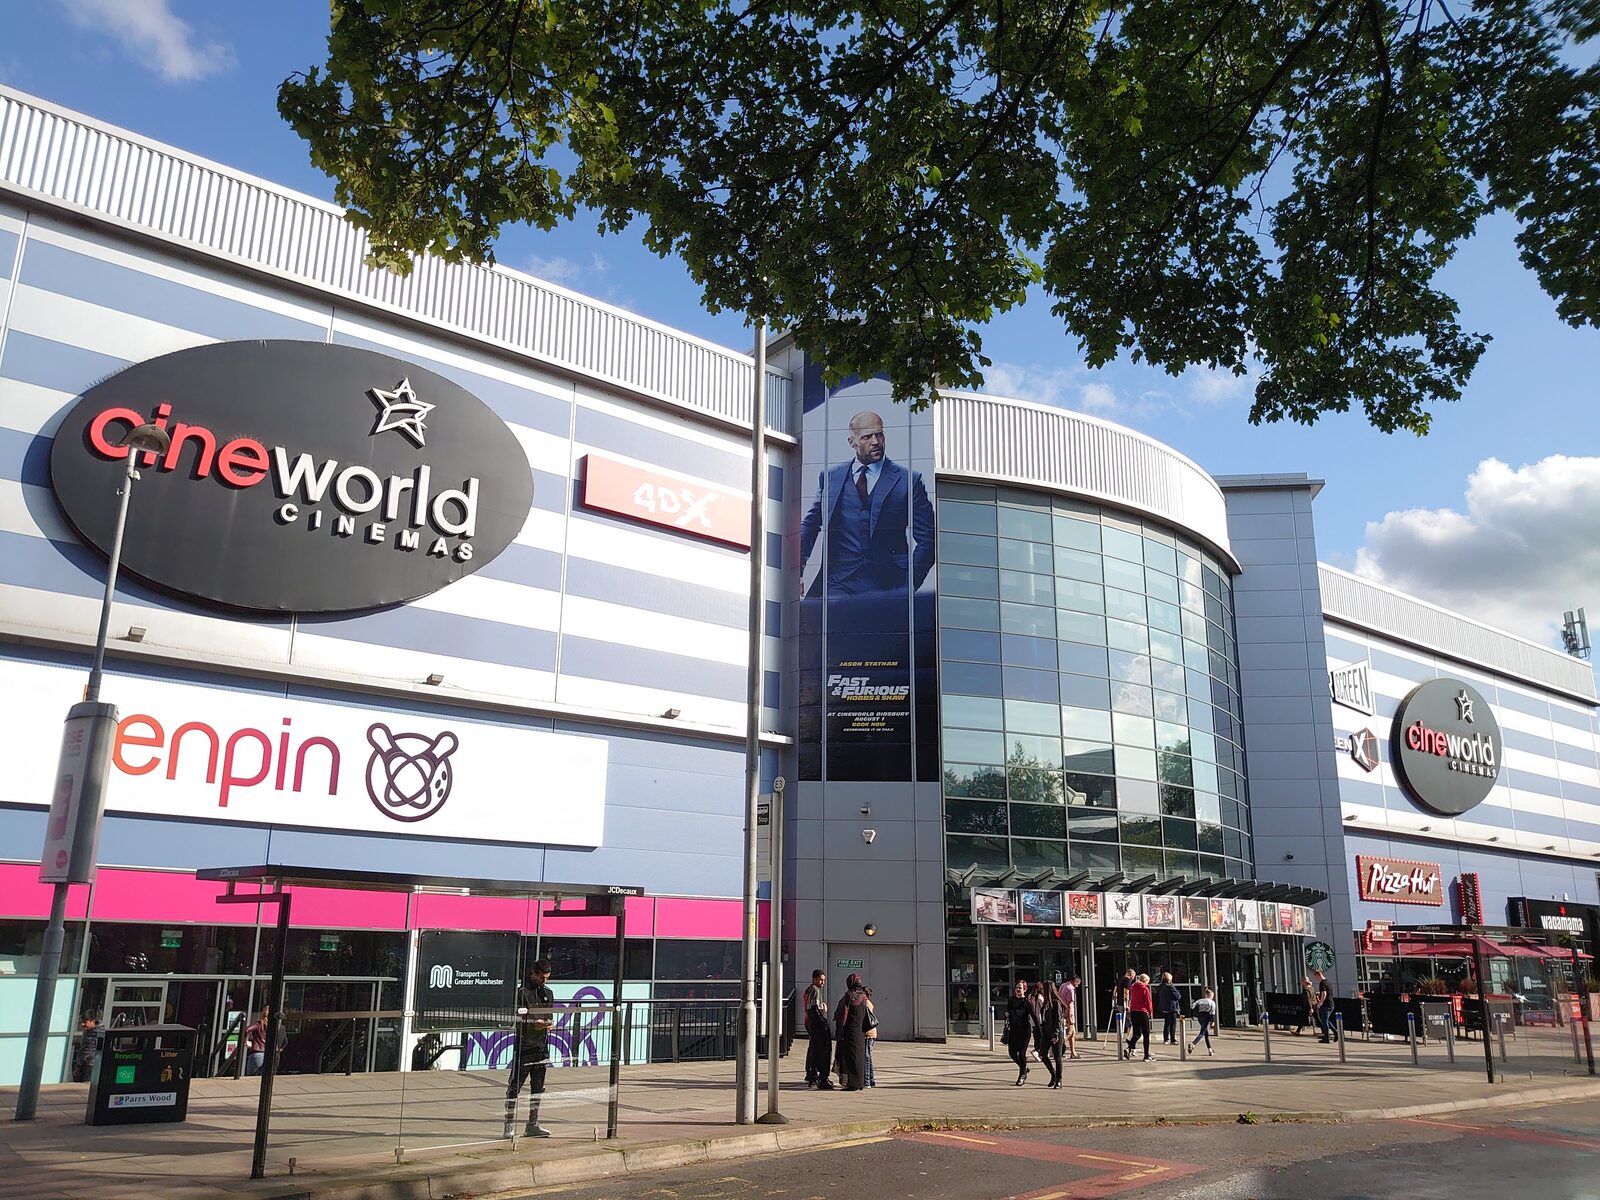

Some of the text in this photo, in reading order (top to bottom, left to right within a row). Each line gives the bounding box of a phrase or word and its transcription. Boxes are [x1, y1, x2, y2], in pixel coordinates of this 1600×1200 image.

[88, 403, 480, 537] cineworld
[632, 482, 720, 529] 4DX
[280, 503, 474, 561] CINEMAS
[1335, 666, 1370, 708] SCREEN
[84, 685, 340, 807] enpin
[1408, 720, 1496, 766] cineworld
[1451, 760, 1498, 778] CINEMAS
[1371, 863, 1440, 893] Pizza Hut
[607, 886, 638, 895] JCDecaux
[1541, 915, 1585, 932] wagamama
[454, 978, 504, 986] Greater Manchester
[455, 970, 480, 979] Transport
[115, 1052, 143, 1060] Recycling
[124, 1094, 172, 1103] Parrs Wood
